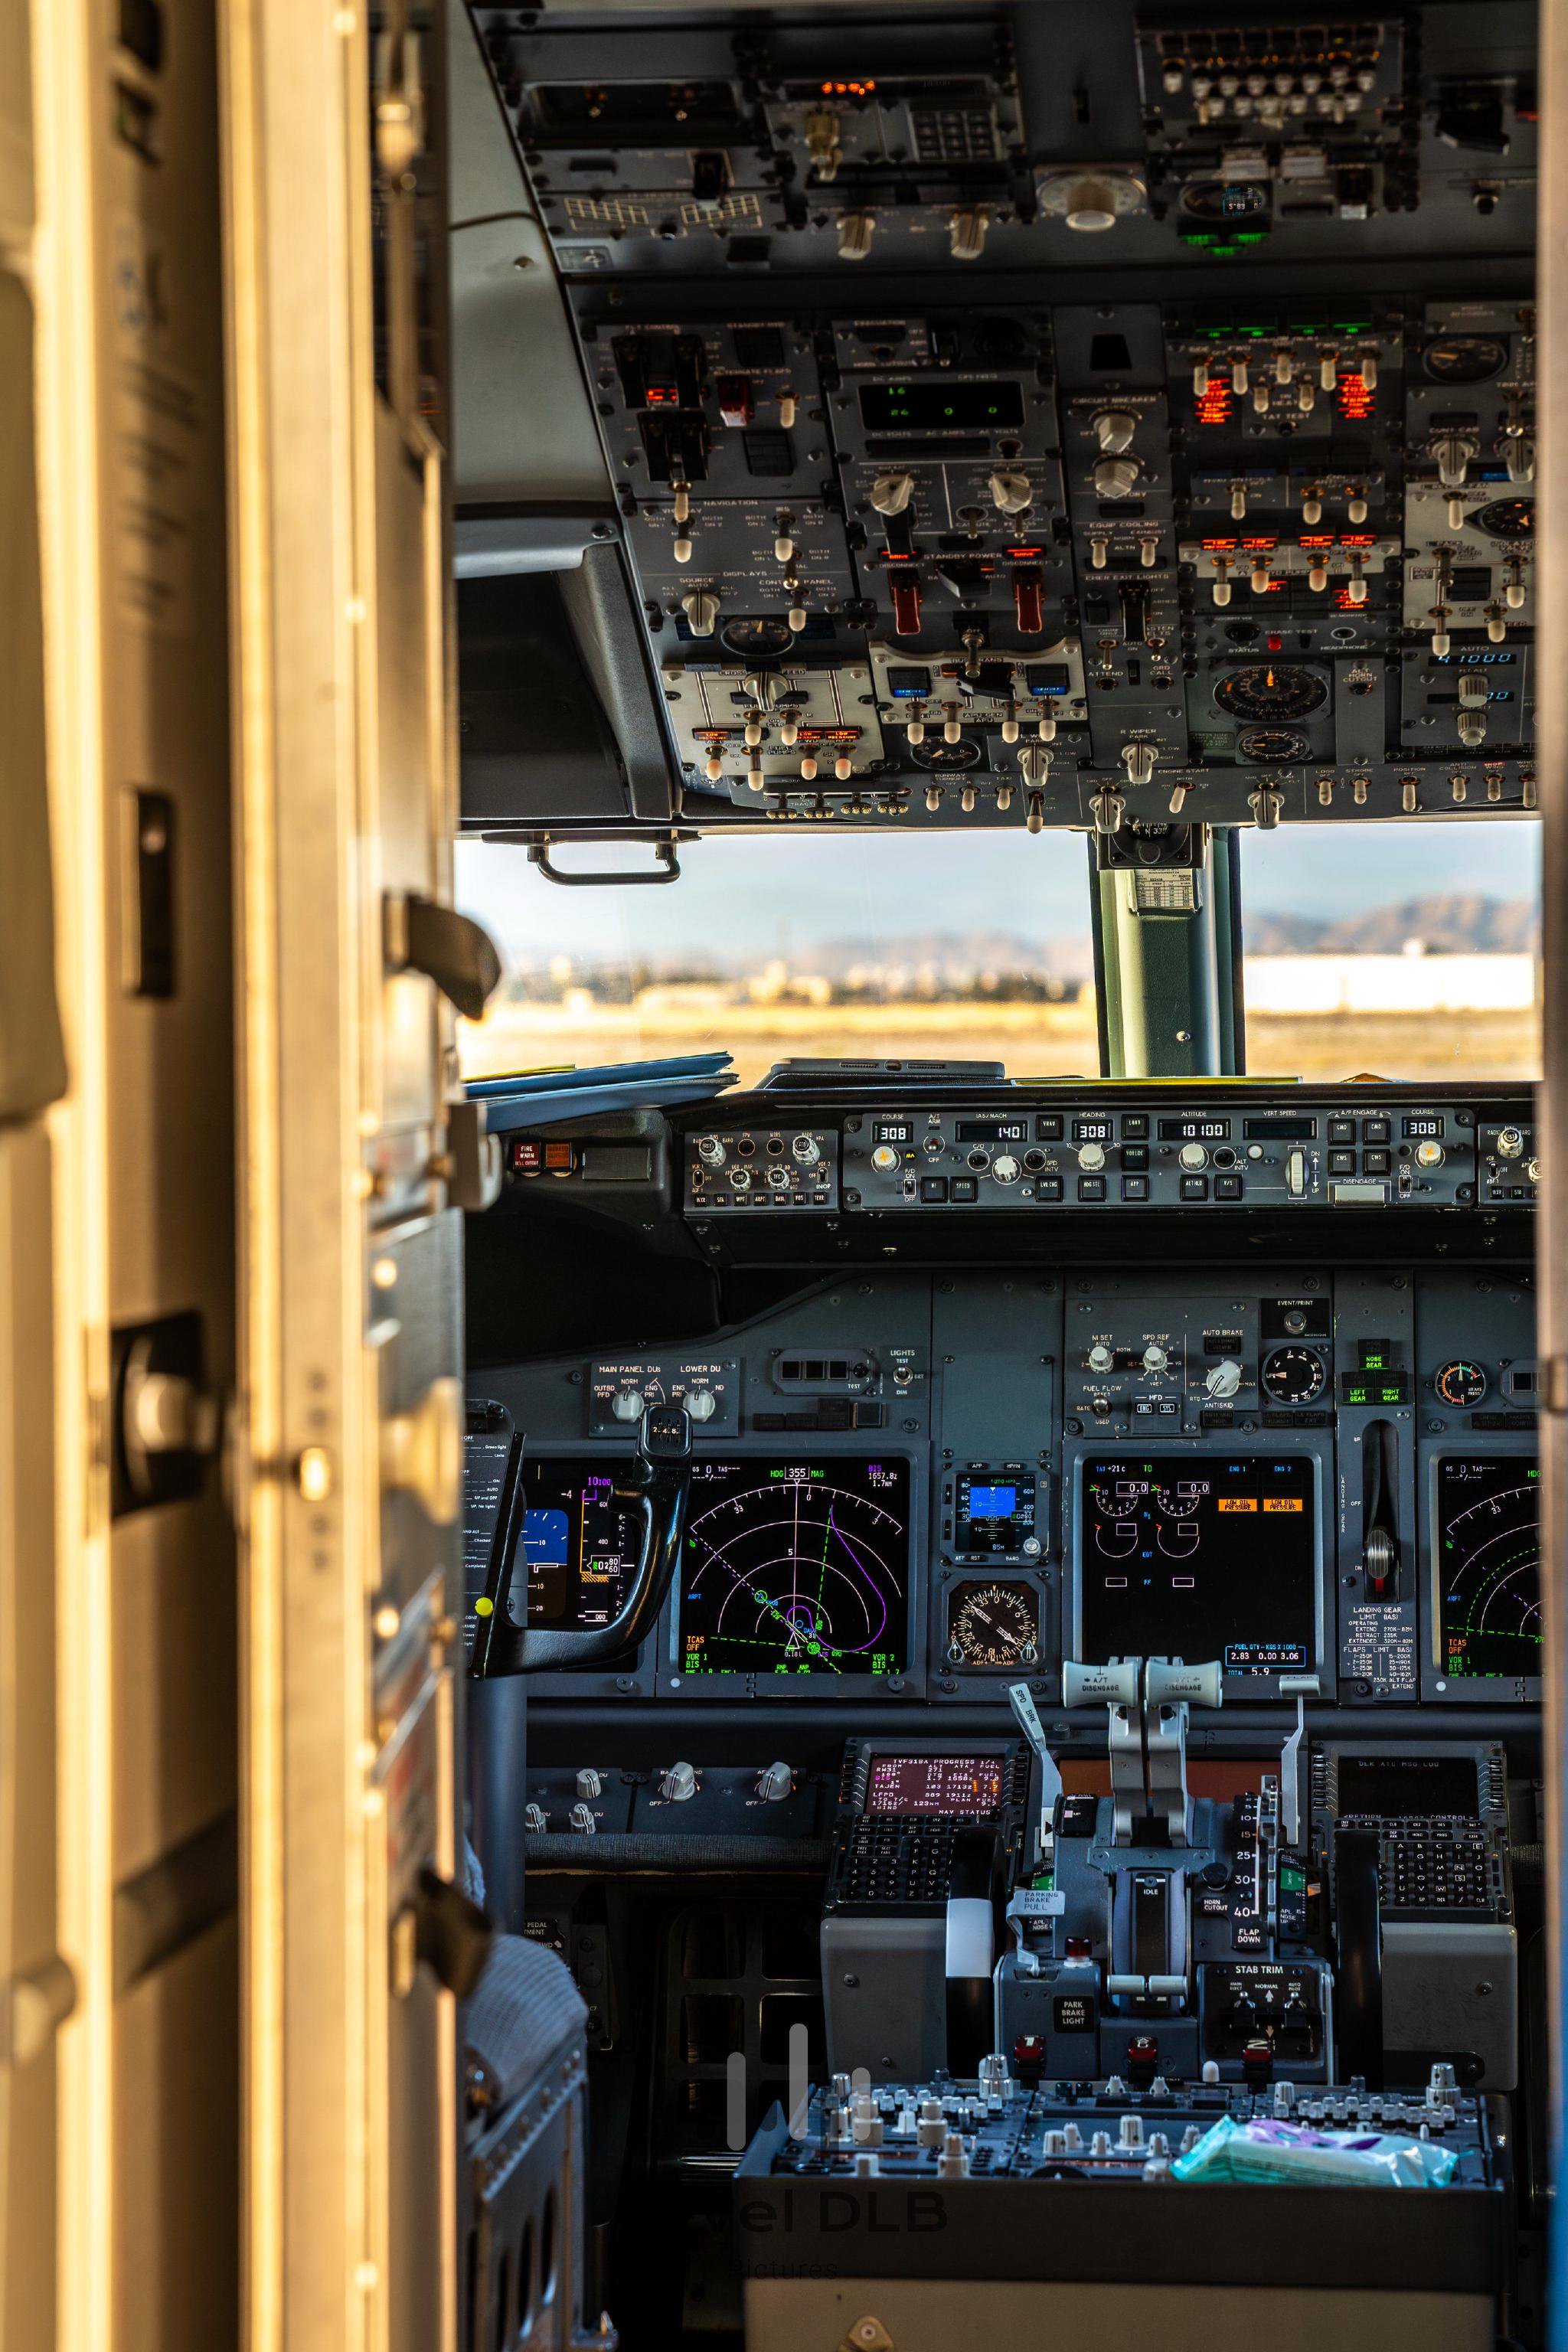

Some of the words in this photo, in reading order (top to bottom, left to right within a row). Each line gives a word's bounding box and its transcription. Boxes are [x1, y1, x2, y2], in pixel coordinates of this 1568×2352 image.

[1438, 654, 1511, 663] 41000
[998, 1127, 1019, 1138] 140
[1080, 1126, 1105, 1137] 308
[1410, 1122, 1436, 1133] 308
[881, 1128, 906, 1139] 308
[1016, 1689, 1026, 1703] SPD
[1026, 1710, 1037, 1723] BRK
[1234, 1908, 1250, 1917] 40
[1238, 1935, 1260, 1943] DOWN
